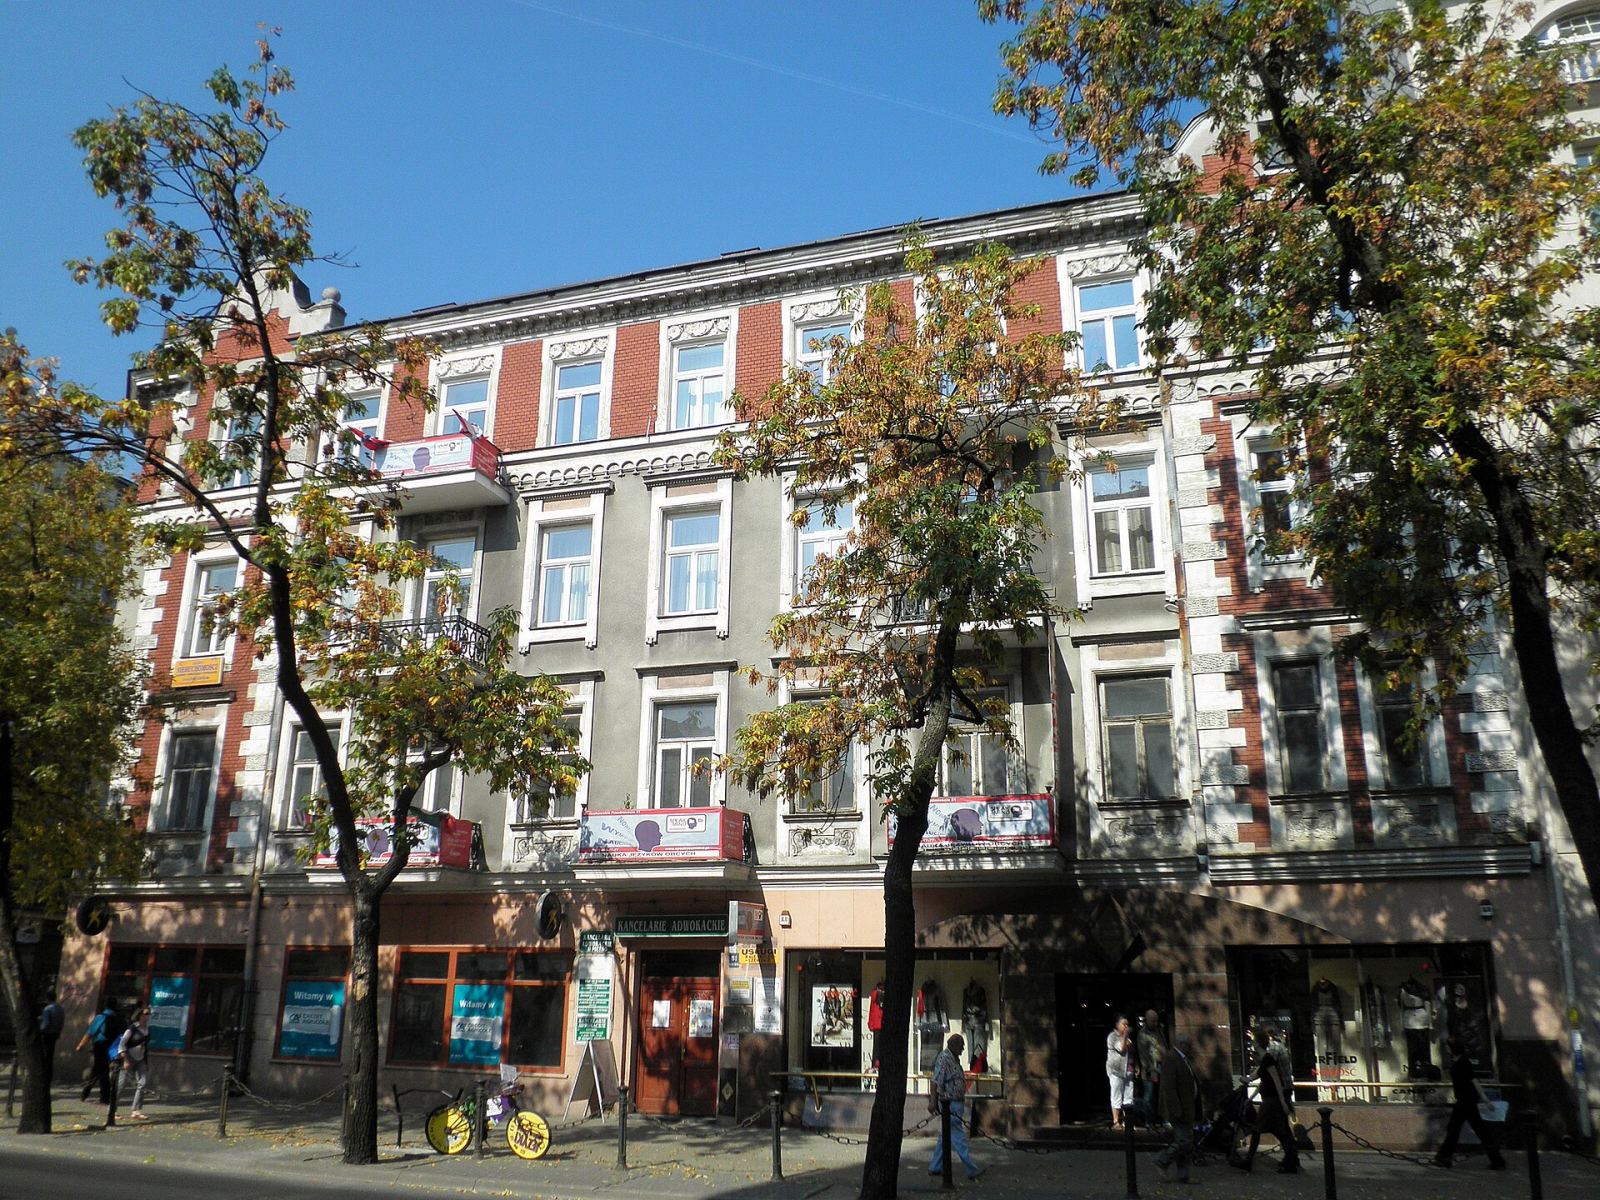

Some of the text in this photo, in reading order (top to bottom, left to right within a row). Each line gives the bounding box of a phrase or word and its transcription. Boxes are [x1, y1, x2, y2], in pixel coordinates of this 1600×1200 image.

[618, 919, 725, 932] KANCELARIE ADWOKACKIE
[154, 991, 177, 1000] Witamy
[293, 991, 334, 1002] Witamy w
[459, 998, 496, 1010] Witamy w
